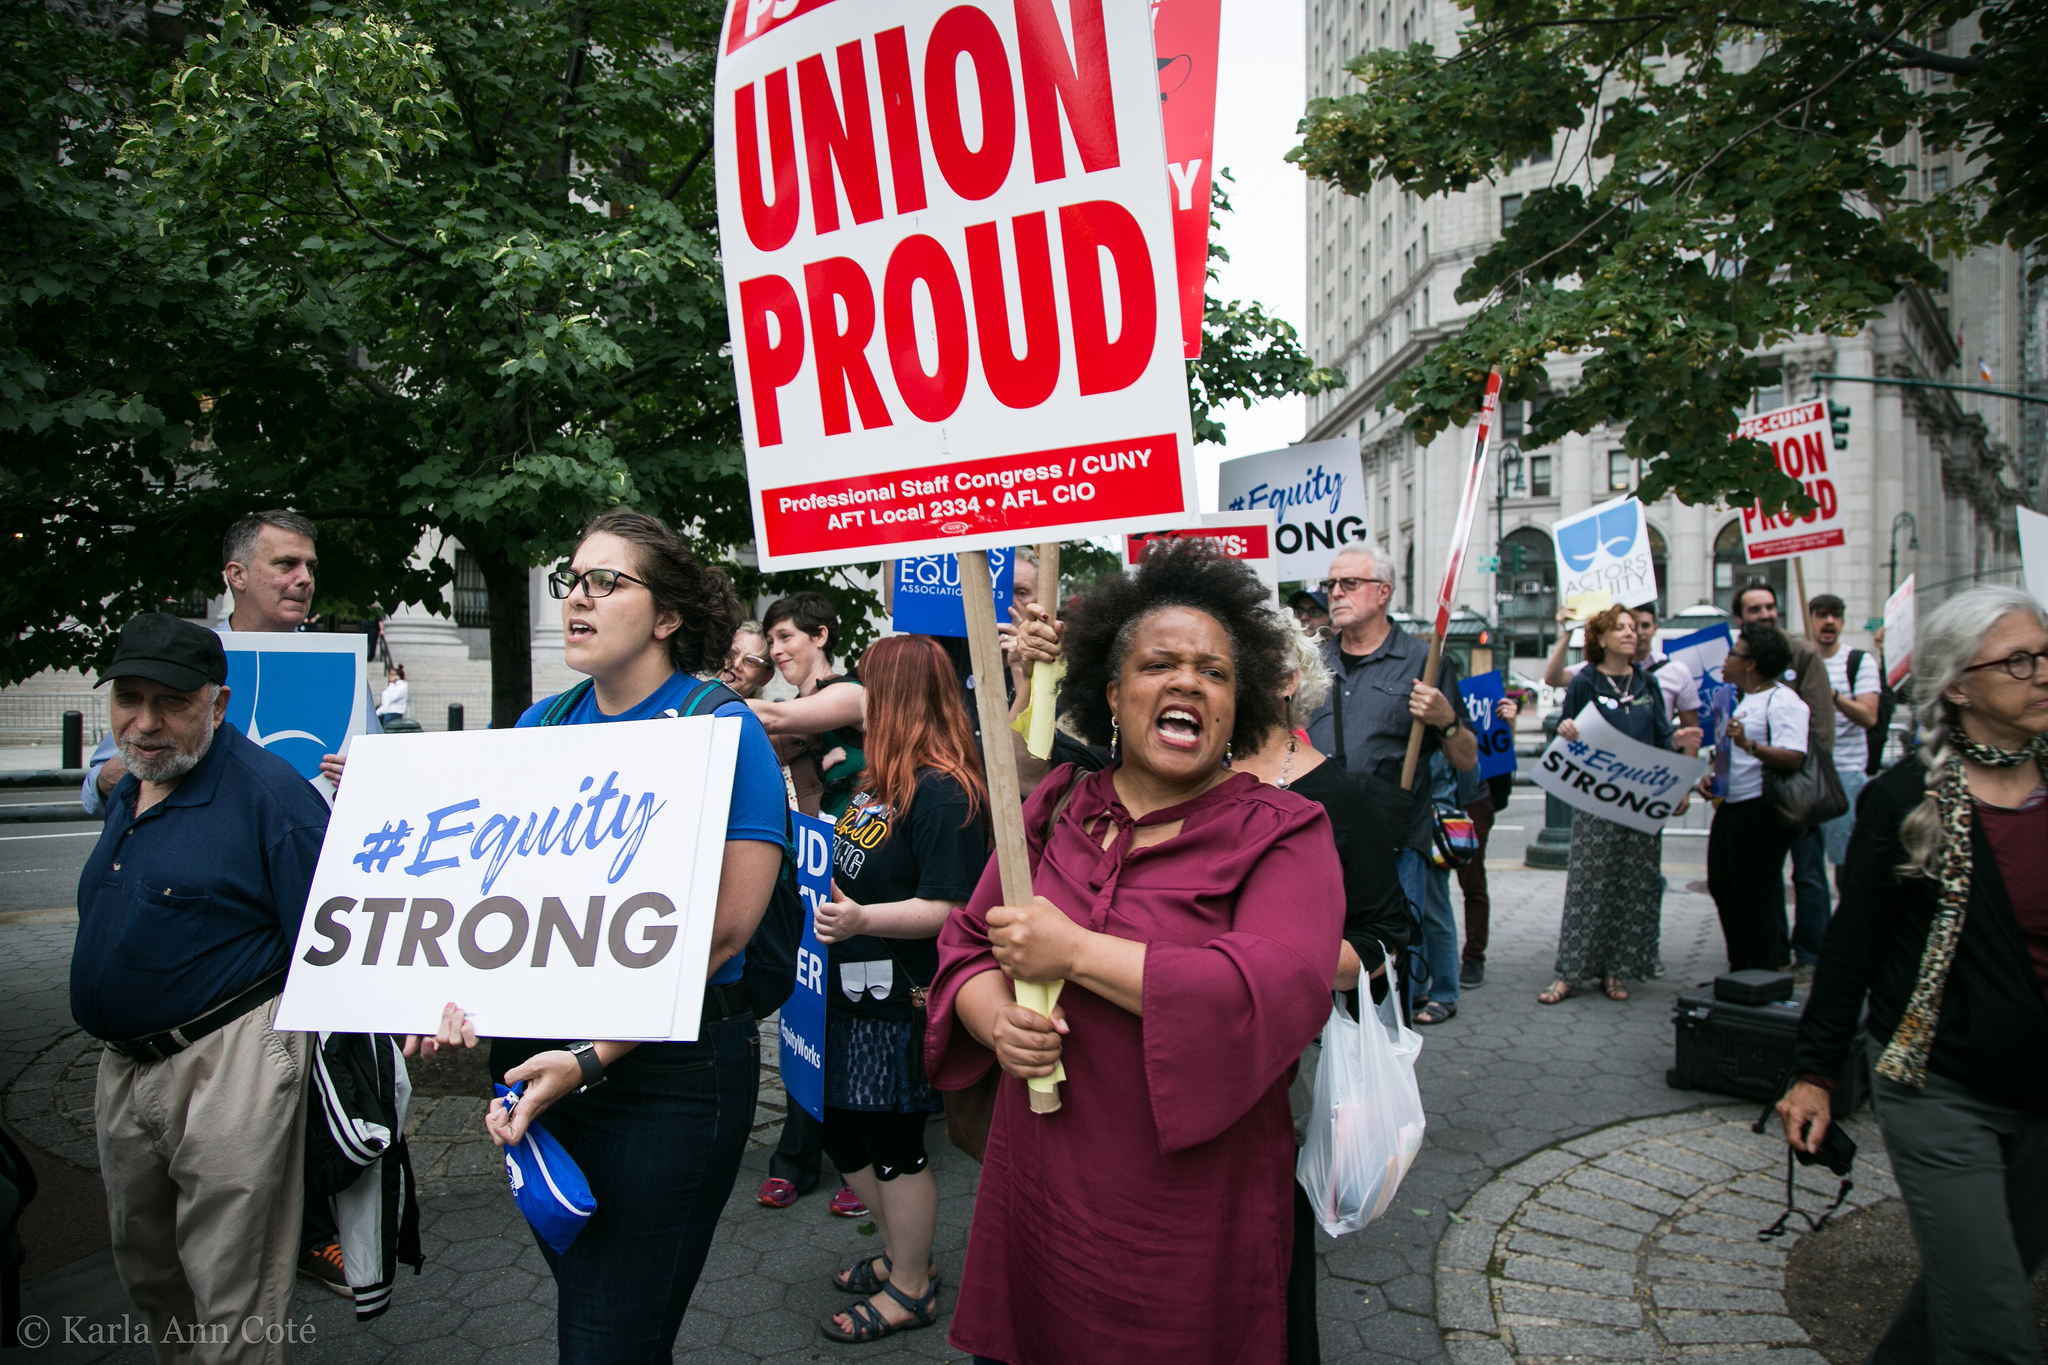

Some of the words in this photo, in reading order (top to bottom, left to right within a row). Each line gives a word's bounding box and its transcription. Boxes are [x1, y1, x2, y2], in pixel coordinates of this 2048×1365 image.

[735, 0, 1120, 252] UNION
[739, 200, 1157, 448] PROUD
[780, 483, 896, 514] Professional
[901, 475, 951, 498] Staff
[954, 463, 1063, 491] Congress
[1068, 458, 1077, 477] /
[1082, 449, 1152, 474] CUNY
[1772, 431, 1828, 479] ION
[827, 512, 865, 531] AFT
[871, 504, 924, 525] Local
[930, 496, 980, 518] 2334
[1002, 489, 1047, 510] AFL
[1053, 481, 1096, 504] CIO
[1229, 465, 1347, 524] #Equity
[1275, 516, 1367, 555] ONG
[901, 559, 1004, 588] EQUY
[901, 585, 963, 597] ASSOCIATIO
[1543, 751, 1672, 819] STRONG
[1567, 739, 1679, 797] #Equity
[352, 770, 668, 895] #Equity
[302, 891, 679, 970] STRONG
